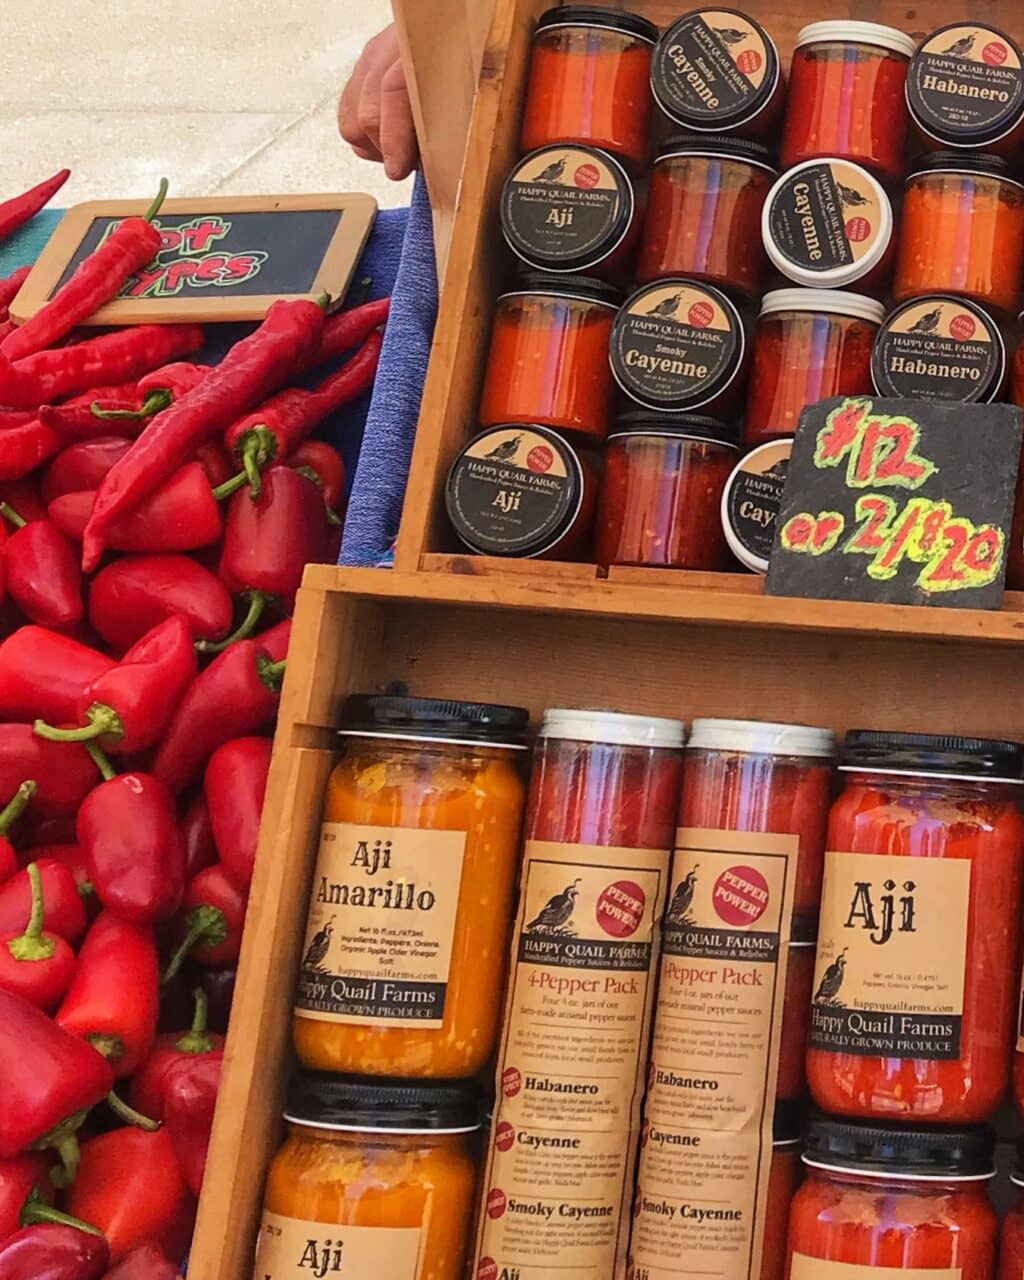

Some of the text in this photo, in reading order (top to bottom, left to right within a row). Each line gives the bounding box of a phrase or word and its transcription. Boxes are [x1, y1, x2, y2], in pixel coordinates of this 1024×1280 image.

[668, 44, 720, 109] Cayenne
[923, 75, 1009, 102] Habanero
[793, 183, 823, 261] Cayenne
[655, 344, 687, 358] Smoky
[625, 349, 708, 379] Cayenne
[890, 356, 980, 380] Habanero
[813, 398, 937, 489] $12
[745, 478, 775, 495] HAPPY
[351, 840, 392, 875] Aji
[317, 877, 436, 911] Amarillo
[722, 872, 768, 903] PEPPER
[715, 887, 761, 918] POWER!
[844, 880, 917, 945] Aji
[524, 939, 562, 954] HAPPY
[565, 944, 605, 958] QUAIL
[686, 934, 722, 947] QUAIL
[528, 971, 639, 995] 4-Pepper Pack
[722, 968, 763, 986] Pack
[331, 980, 436, 1003] Quail Farms
[332, 1004, 376, 1015] GROWN
[377, 1006, 433, 1018] PRODUCE
[707, 1006, 735, 1016] pepper
[811, 1008, 953, 1036] Happy Quail Farms
[851, 1036, 952, 1052] GROWN PRODUCE
[524, 1077, 599, 1096] Habanero
[656, 1071, 719, 1090] Habanero
[517, 1131, 581, 1149] Cayenne
[649, 1127, 701, 1147] Cayenne
[507, 1200, 613, 1220] Smoky Cayenne
[642, 1198, 742, 1223] Smoky Cayenne
[298, 1239, 344, 1278] Aji
